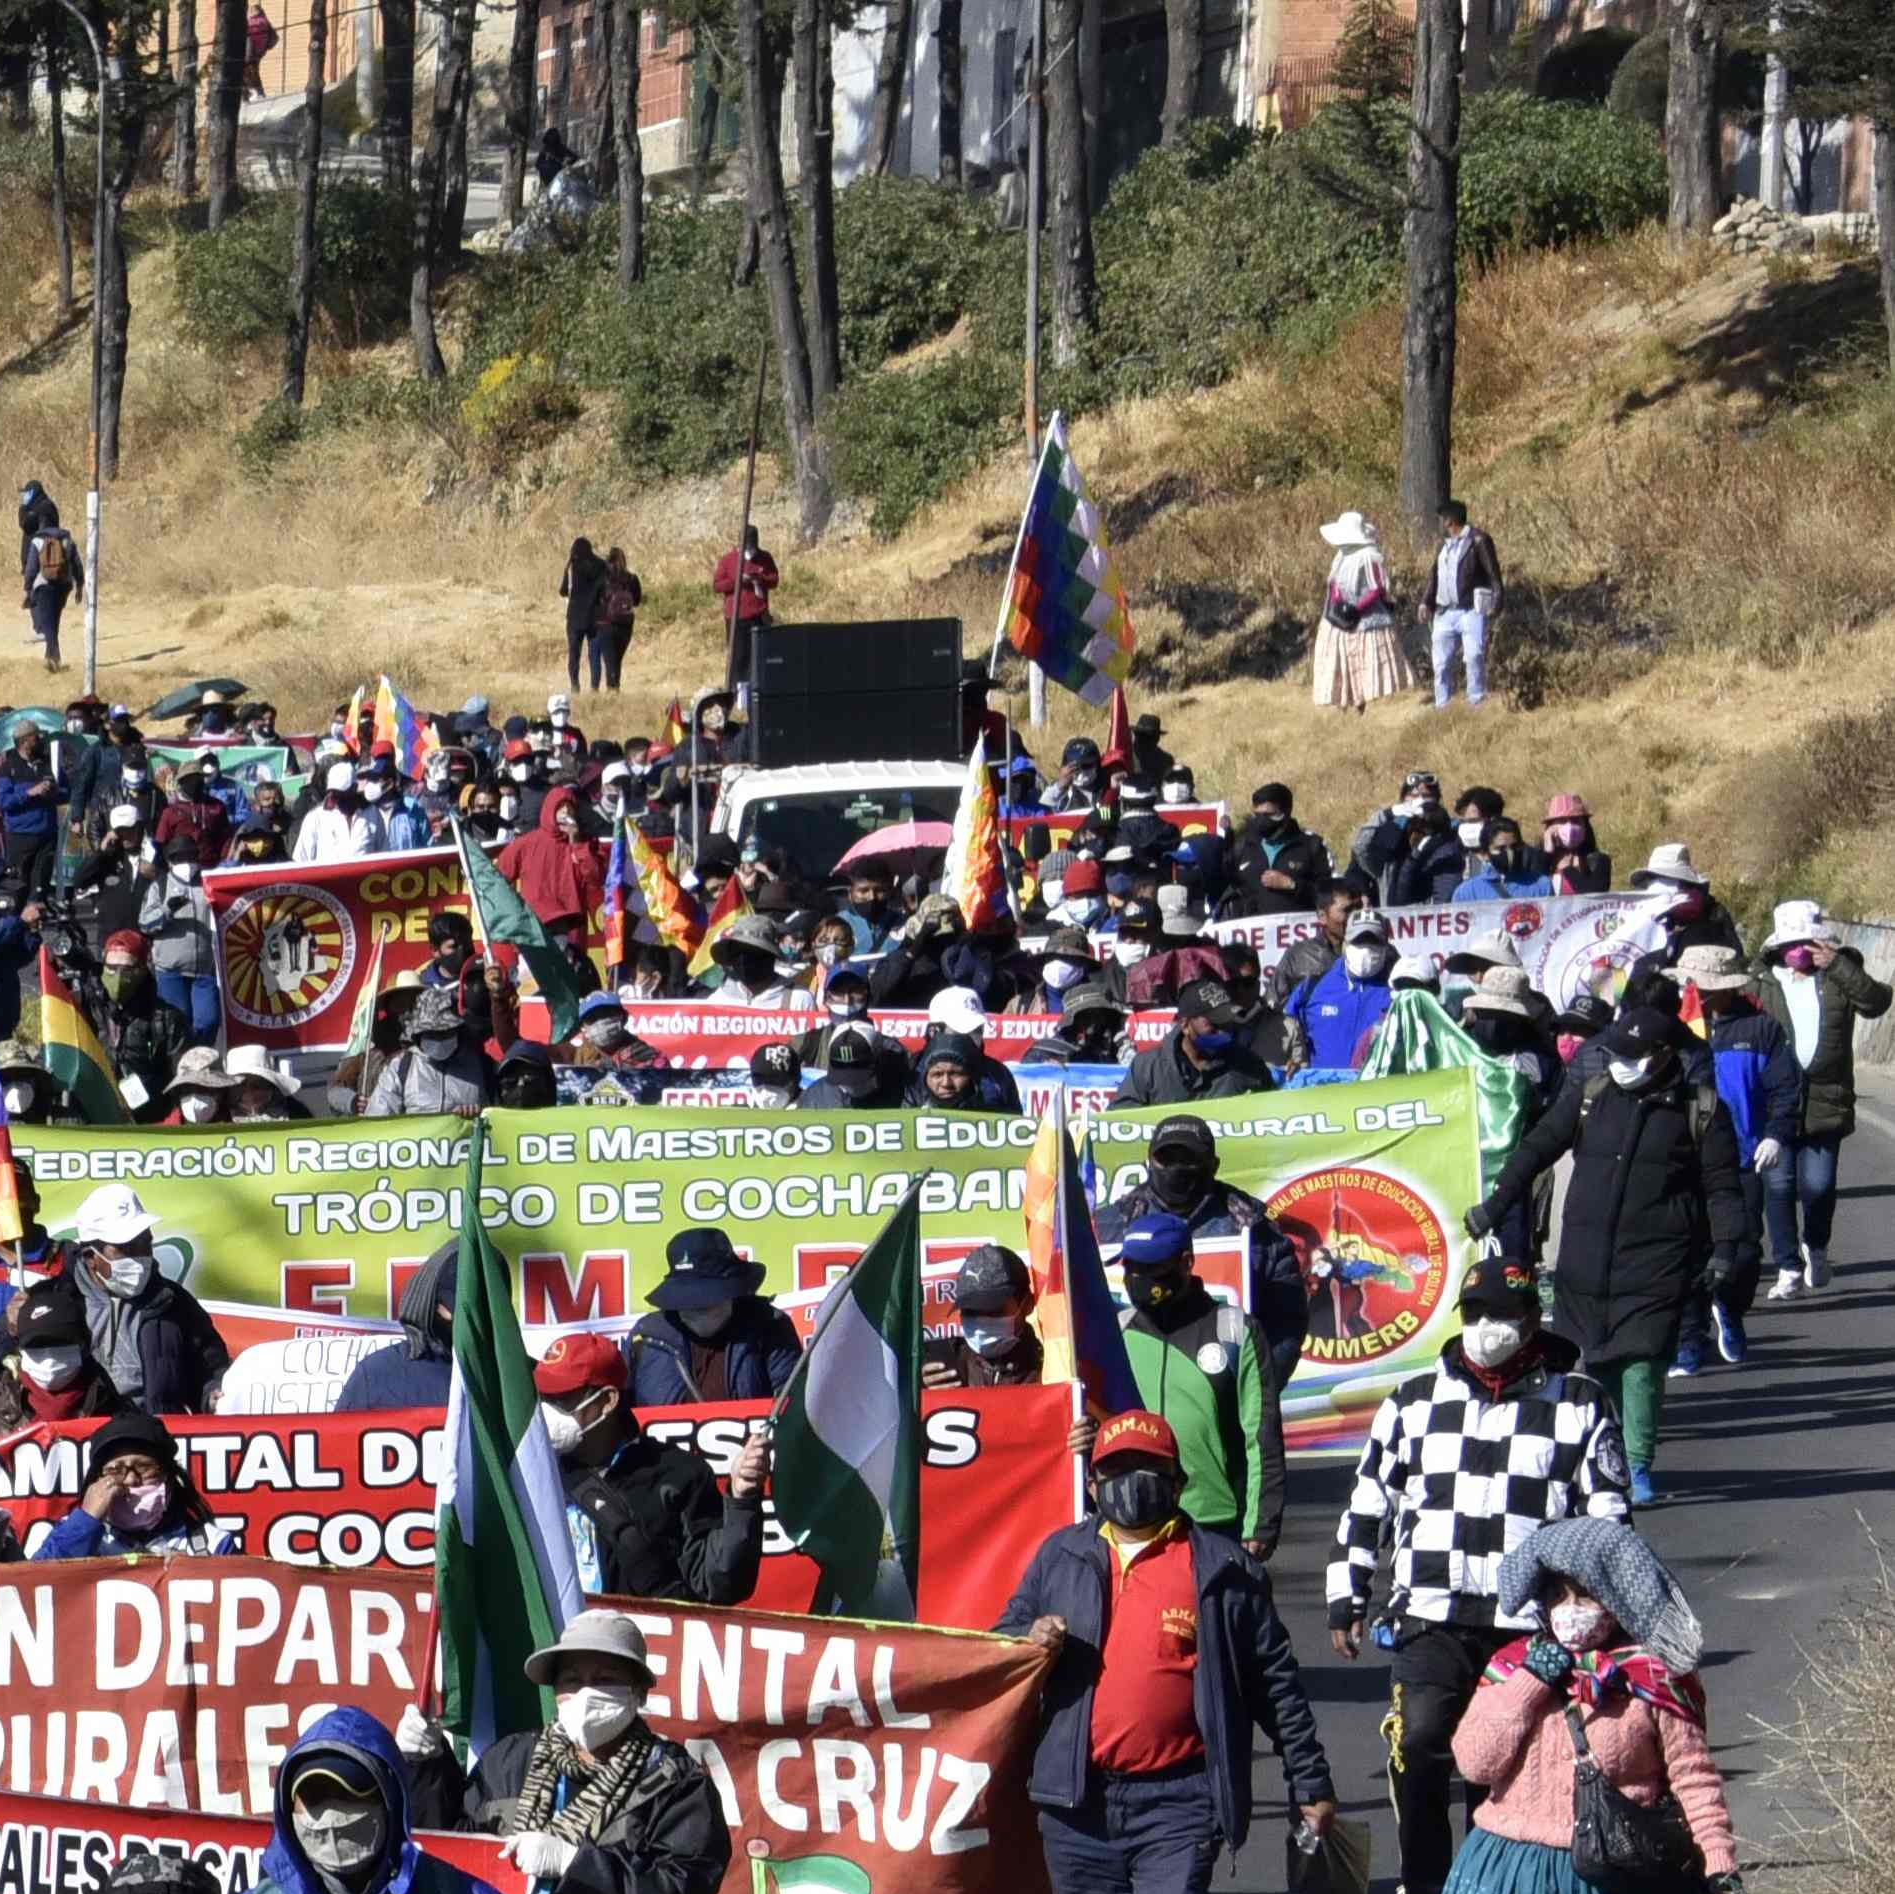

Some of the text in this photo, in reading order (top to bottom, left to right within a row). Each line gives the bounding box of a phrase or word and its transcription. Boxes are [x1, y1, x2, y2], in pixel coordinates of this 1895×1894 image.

[702, 1015, 809, 1036] REGIONAL
[285, 1134, 507, 1175] REGIONAL
[517, 1132, 577, 1165] DE
[586, 1124, 835, 1163] MAESTROS
[844, 1120, 904, 1154] DE
[1355, 1099, 1444, 1133] DEL
[272, 1176, 557, 1236] TRÓPICO
[577, 1180, 665, 1225] DE
[1305, 1172, 1362, 1193] MAESTROS
[1301, 1309, 1419, 1360] ONMERB
[1101, 1417, 1159, 1444] ARMAR
[756, 1736, 992, 1857] CRUZ
